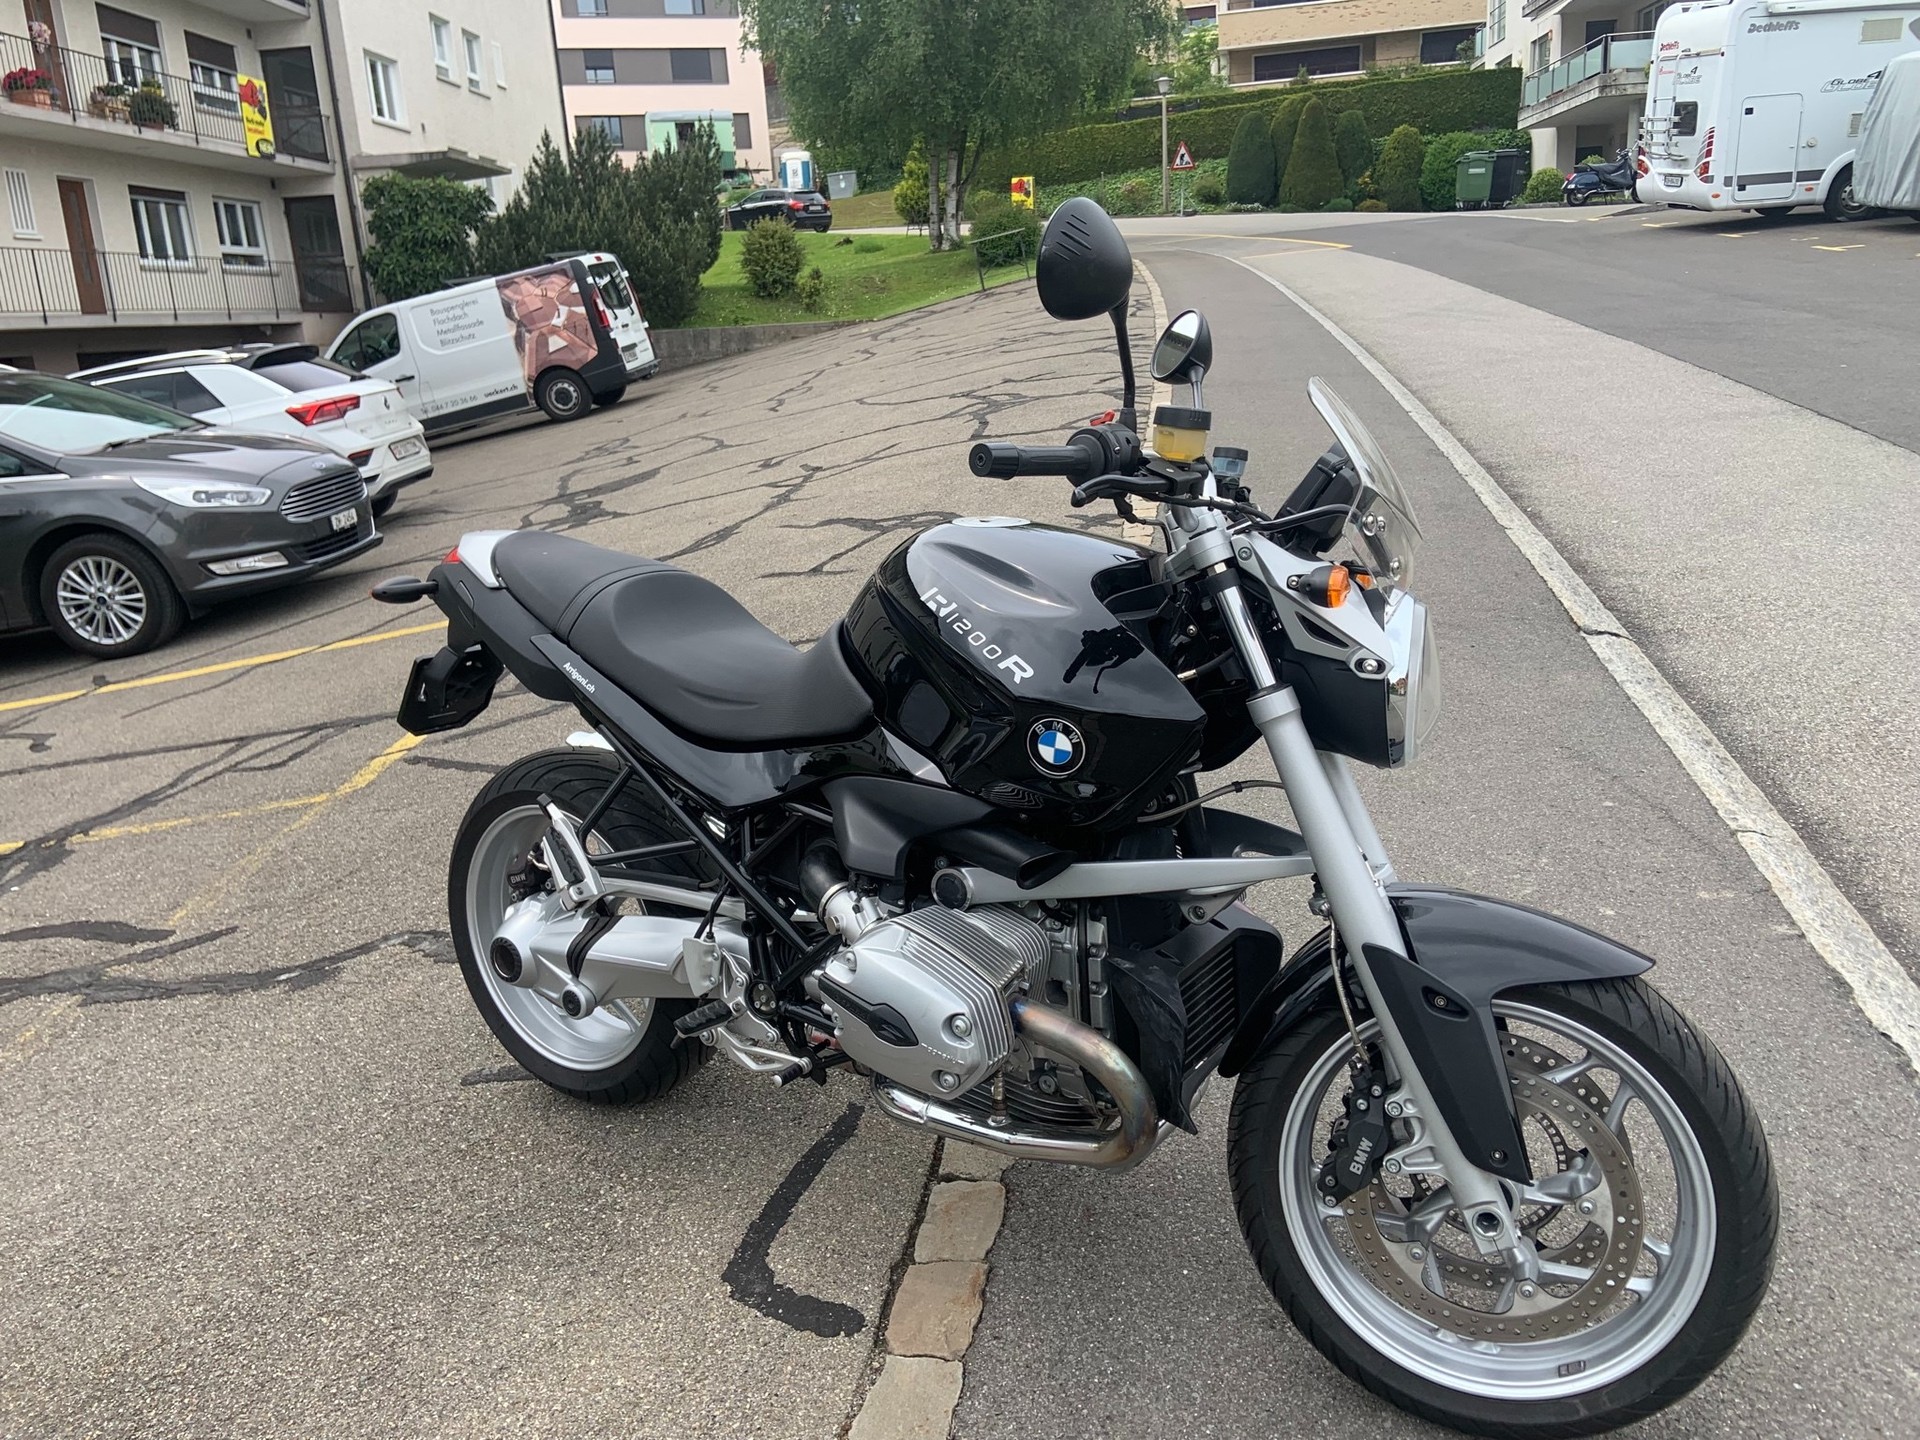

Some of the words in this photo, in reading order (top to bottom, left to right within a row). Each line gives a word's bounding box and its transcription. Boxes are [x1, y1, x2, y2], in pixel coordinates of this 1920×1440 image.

[562, 661, 596, 694] Arrigoni.ch
[1035, 721, 1081, 744] BMW
[510, 873, 526, 884] BMW
[1349, 1136, 1373, 1175] BMW
